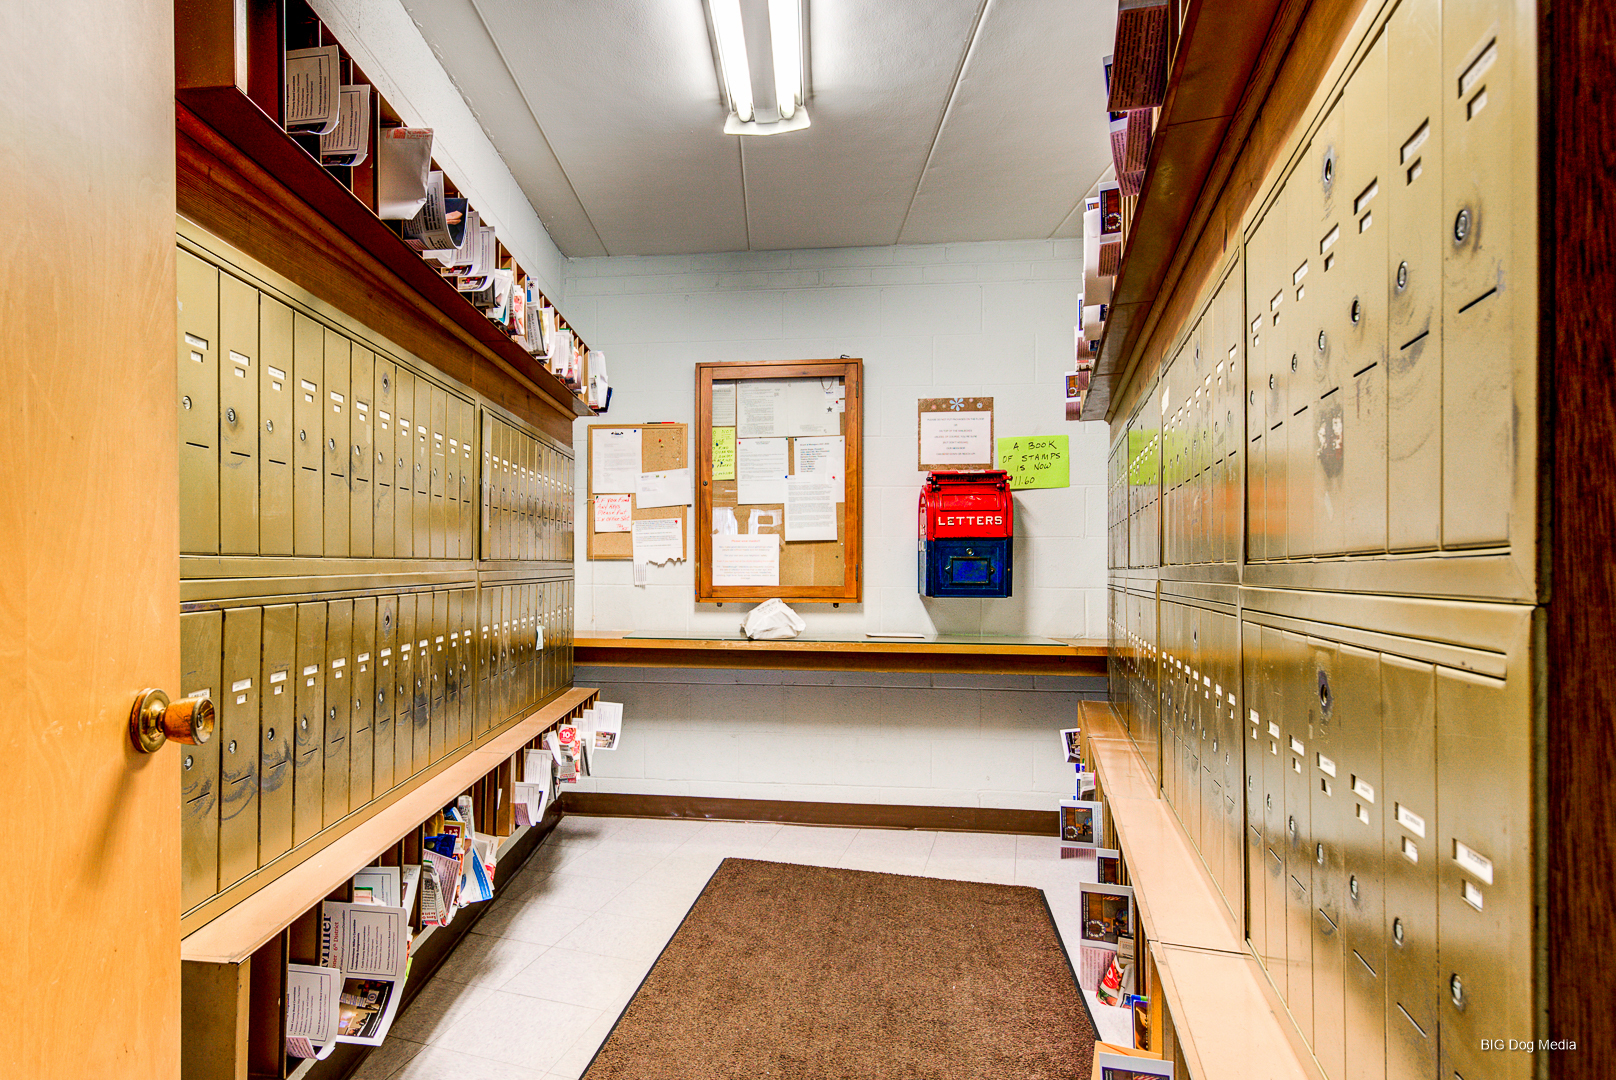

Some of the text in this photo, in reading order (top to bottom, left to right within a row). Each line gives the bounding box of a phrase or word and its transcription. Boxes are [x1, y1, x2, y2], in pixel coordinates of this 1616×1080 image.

[1013, 441, 1057, 451] A BOOK
[1002, 453, 1060, 463] OF STAMPS
[1034, 462, 1051, 470] NOW
[1011, 476, 1035, 485] 11.60
[938, 516, 1002, 525] LETTERS
